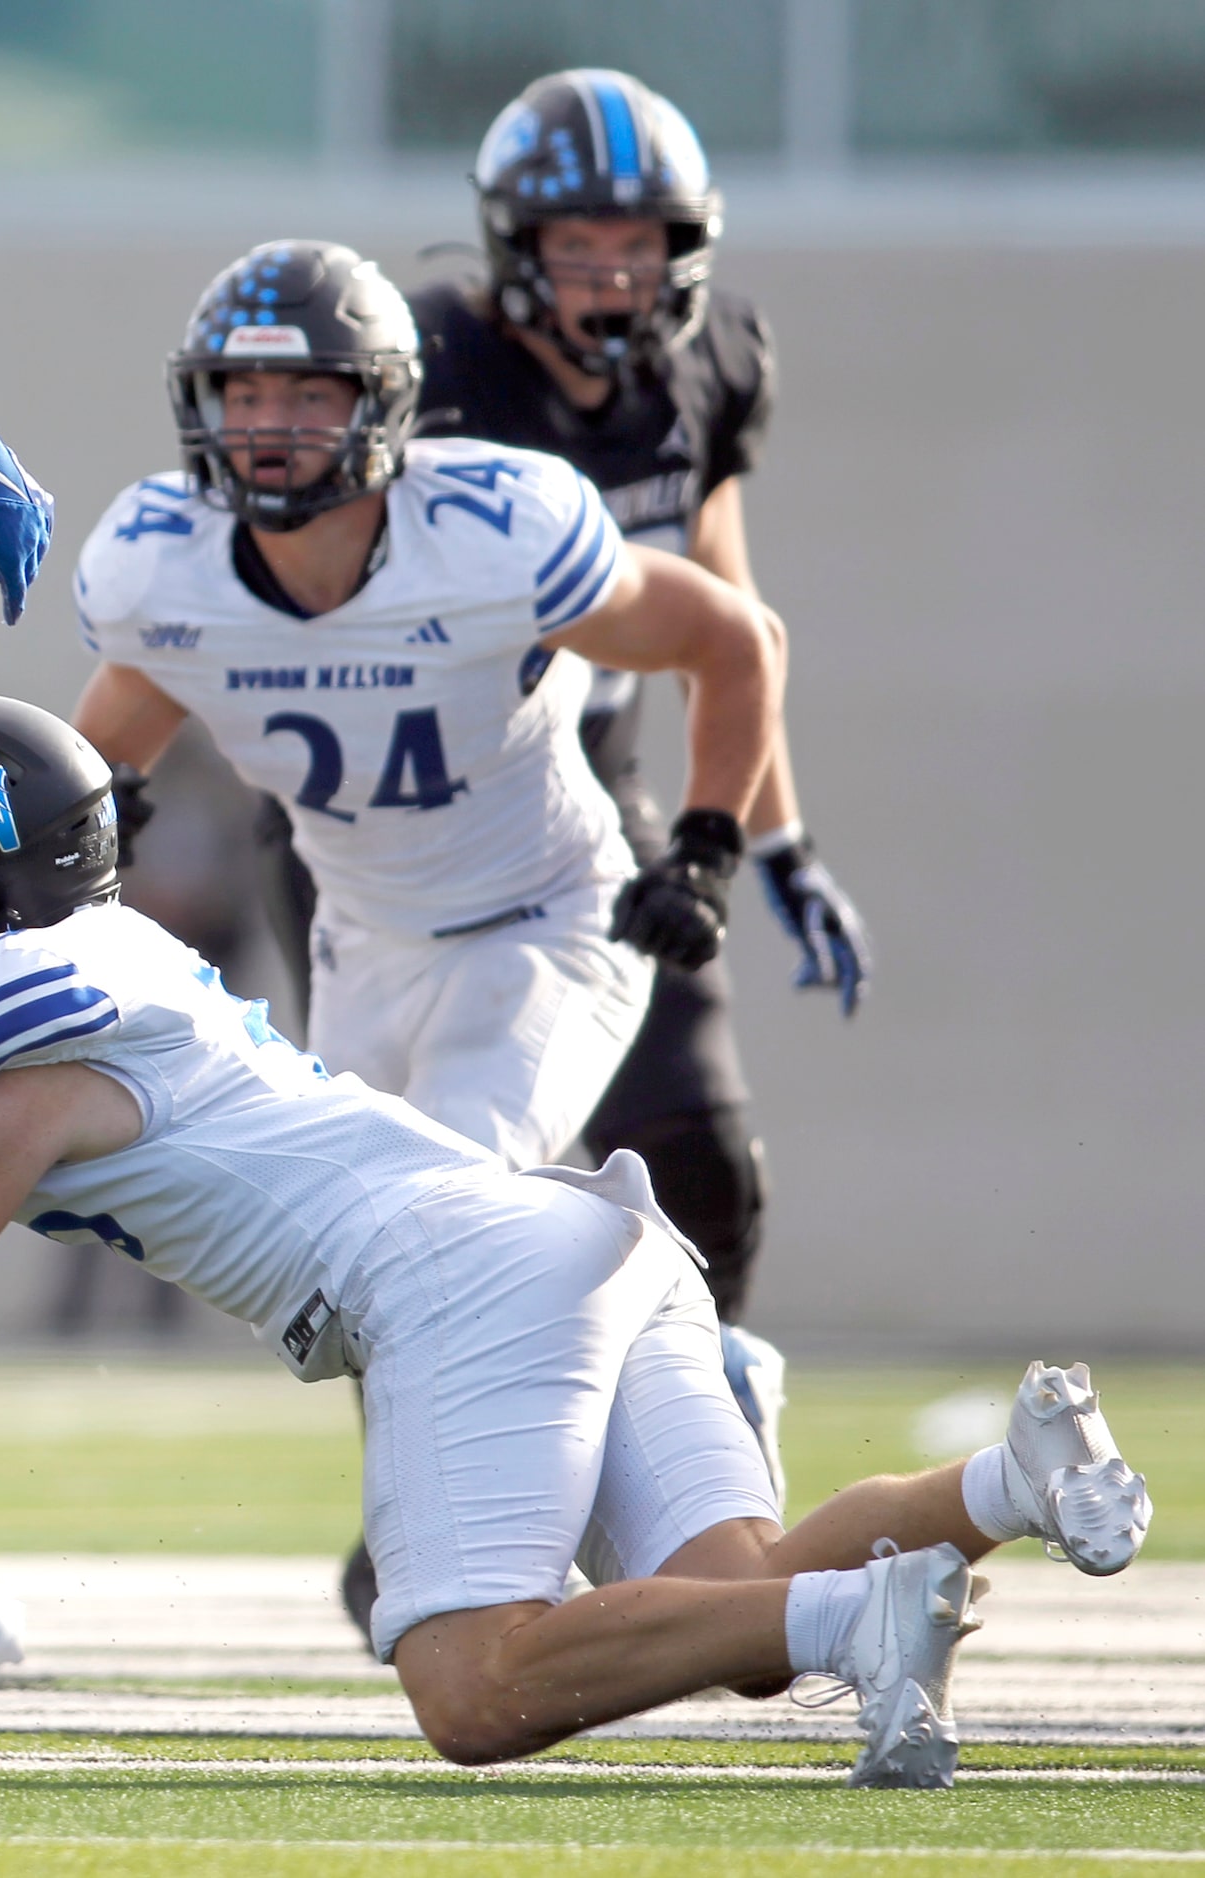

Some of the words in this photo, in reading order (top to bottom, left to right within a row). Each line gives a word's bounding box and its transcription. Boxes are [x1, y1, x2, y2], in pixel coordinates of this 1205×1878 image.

[426, 458, 523, 537] 24
[226, 667, 308, 690] BYRON
[315, 665, 415, 689] NELSON
[263, 705, 469, 824] 24
